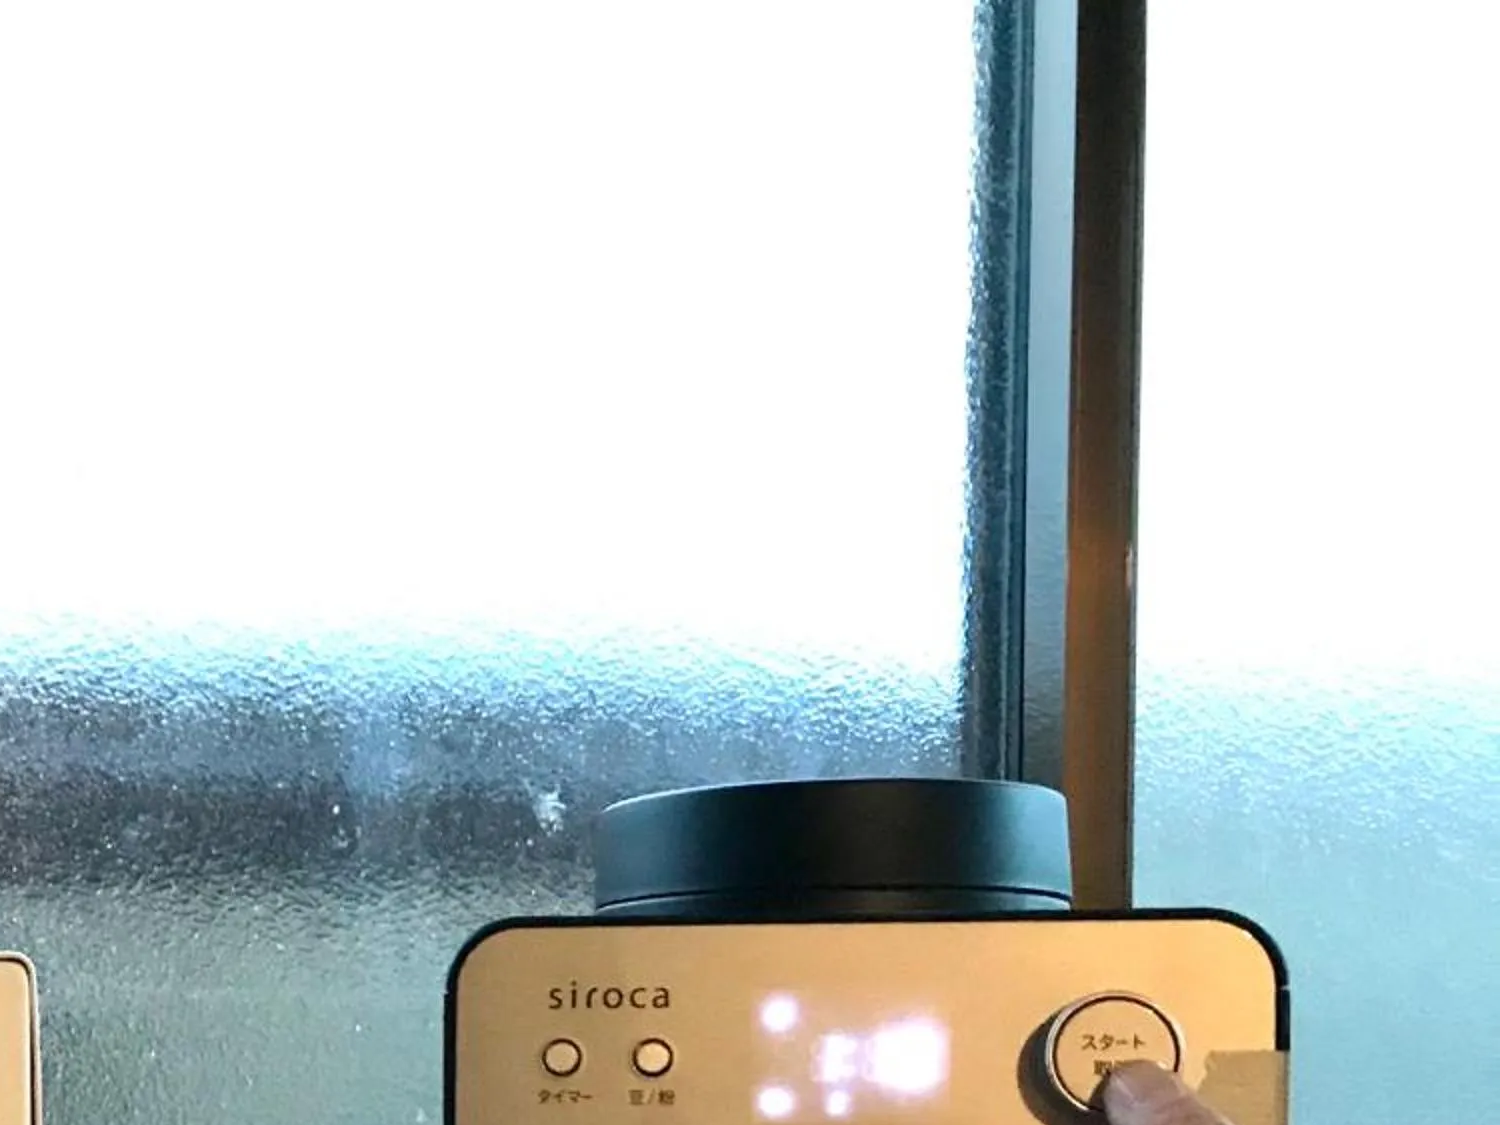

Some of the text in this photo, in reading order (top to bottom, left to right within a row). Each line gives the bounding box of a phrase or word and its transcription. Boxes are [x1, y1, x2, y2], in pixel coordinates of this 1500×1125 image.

[548, 980, 670, 1010] siroca
[1081, 1032, 1146, 1051] スタート
